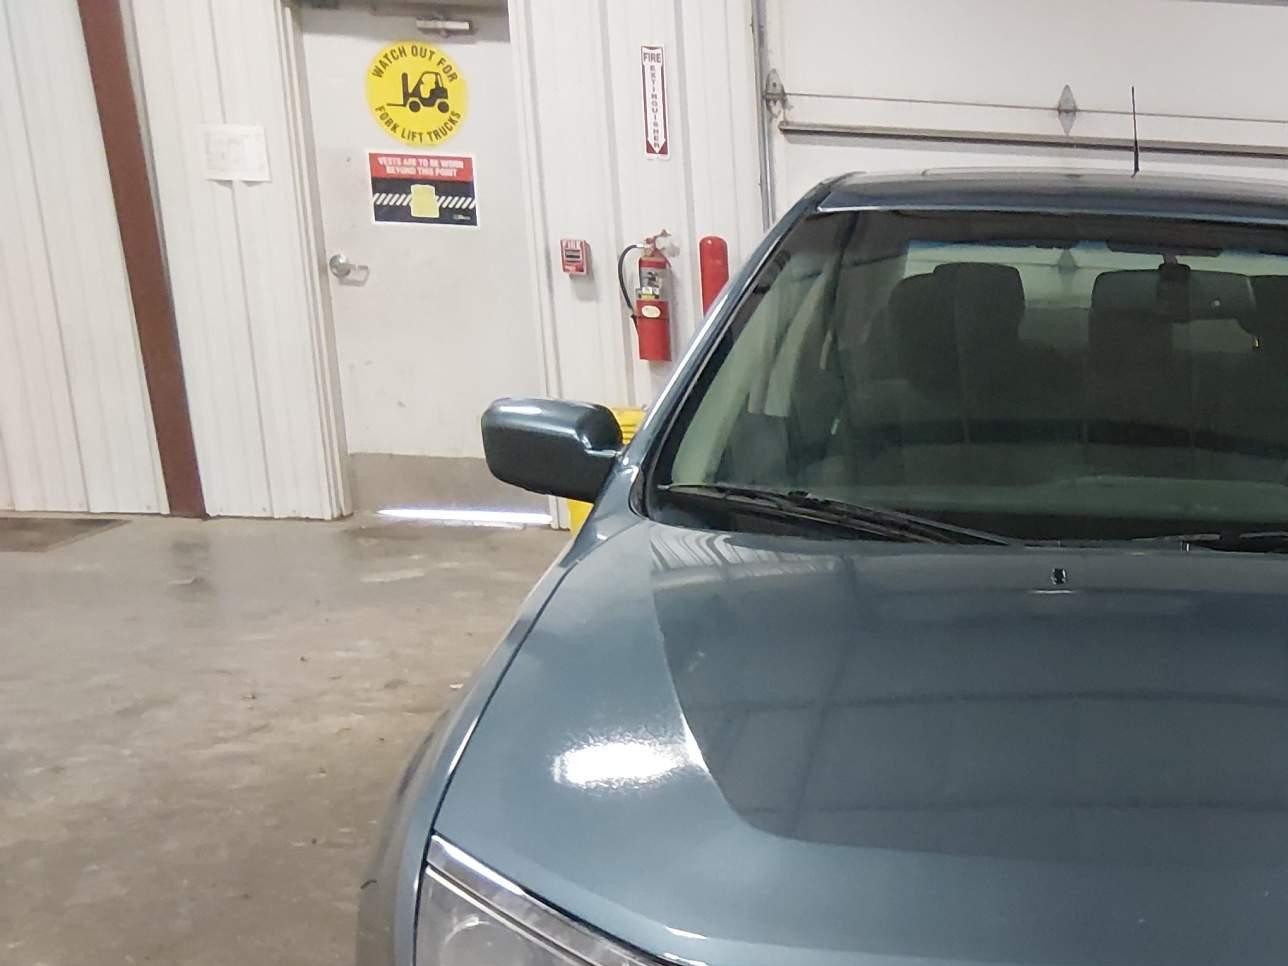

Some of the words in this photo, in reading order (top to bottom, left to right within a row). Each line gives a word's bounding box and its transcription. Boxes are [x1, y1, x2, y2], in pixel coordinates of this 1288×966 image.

[372, 45, 407, 78] WATCH
[411, 45, 435, 61] OUT
[436, 57, 458, 82] FOR
[643, 52, 661, 63] FIRE
[375, 105, 400, 133] FORK
[401, 128, 423, 143] LIFT
[427, 111, 461, 142] TRUCKS
[417, 159, 428, 167] TO
